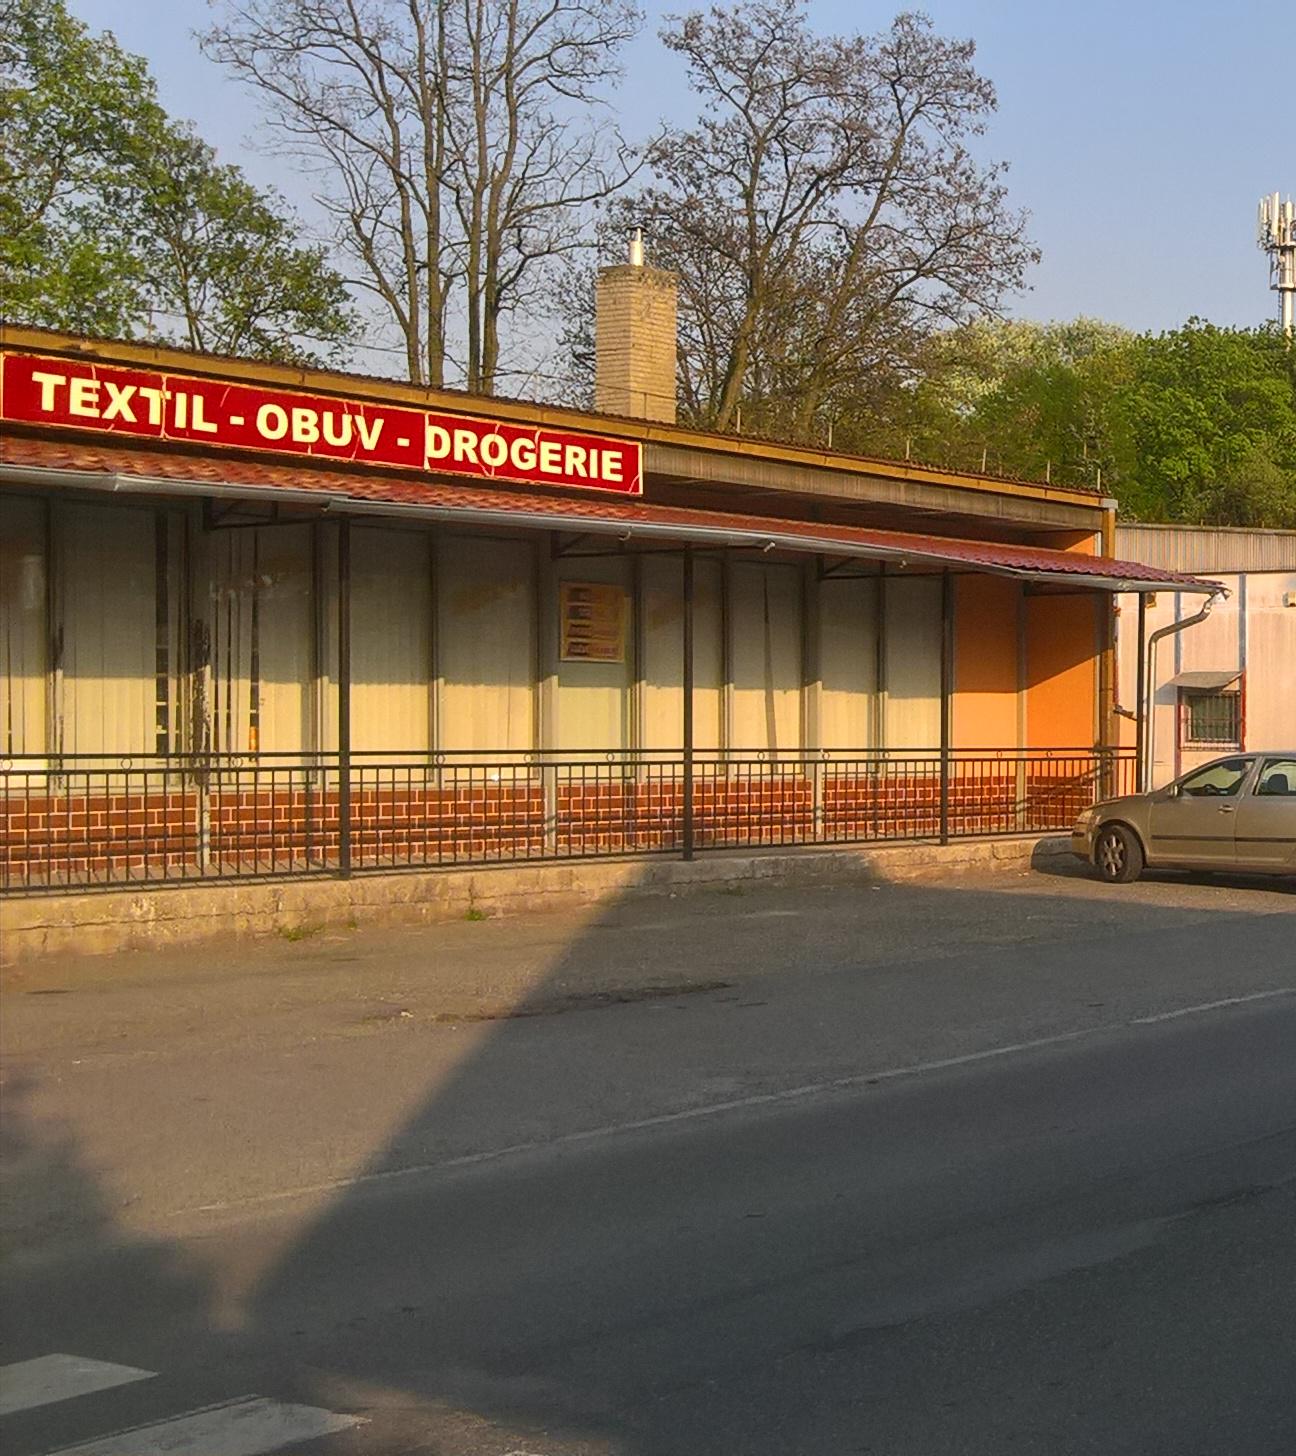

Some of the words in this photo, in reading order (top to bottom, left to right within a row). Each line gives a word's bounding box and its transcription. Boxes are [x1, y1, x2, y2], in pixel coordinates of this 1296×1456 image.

[32, 371, 218, 433] TEXTIL
[229, 415, 246, 426] -
[255, 403, 385, 450] OBUV
[397, 436, 411, 446] -
[427, 428, 624, 482] DROGERIE
